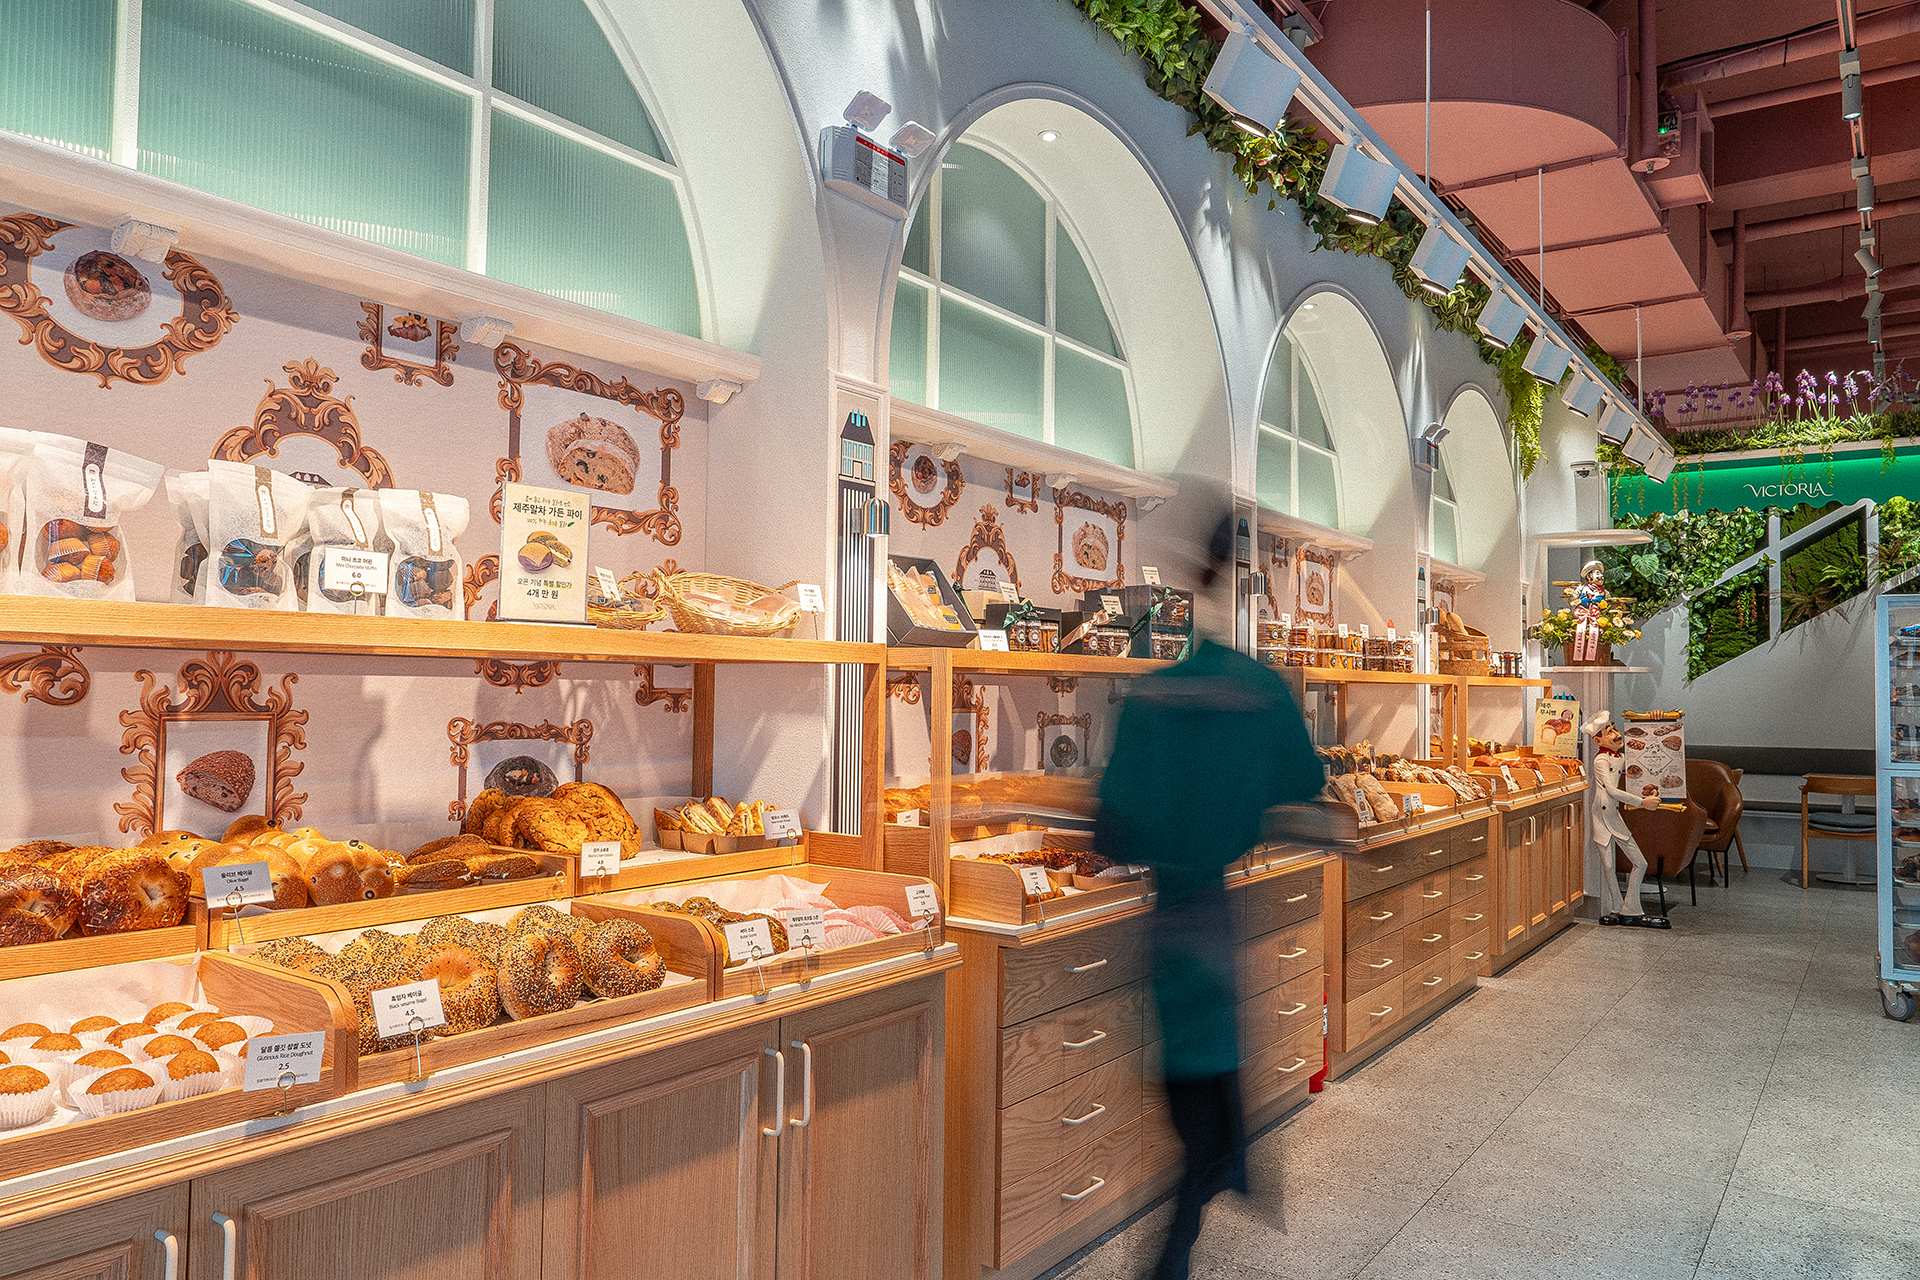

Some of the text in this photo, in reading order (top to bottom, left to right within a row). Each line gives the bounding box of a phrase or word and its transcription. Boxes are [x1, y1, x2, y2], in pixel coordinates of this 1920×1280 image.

[1743, 482, 1835, 498] VICTORIA
[513, 503, 583, 520] 제주말차 가든 파이
[543, 580, 554, 588] 특별
[527, 589, 558, 599] 4개 만 원
[407, 990, 422, 998] 베이글
[287, 1042, 299, 1050] 찹쌀
[300, 1041, 312, 1049] 도넛
[290, 1050, 313, 1058] Doughnut
[278, 1062, 290, 1070] 2.5
